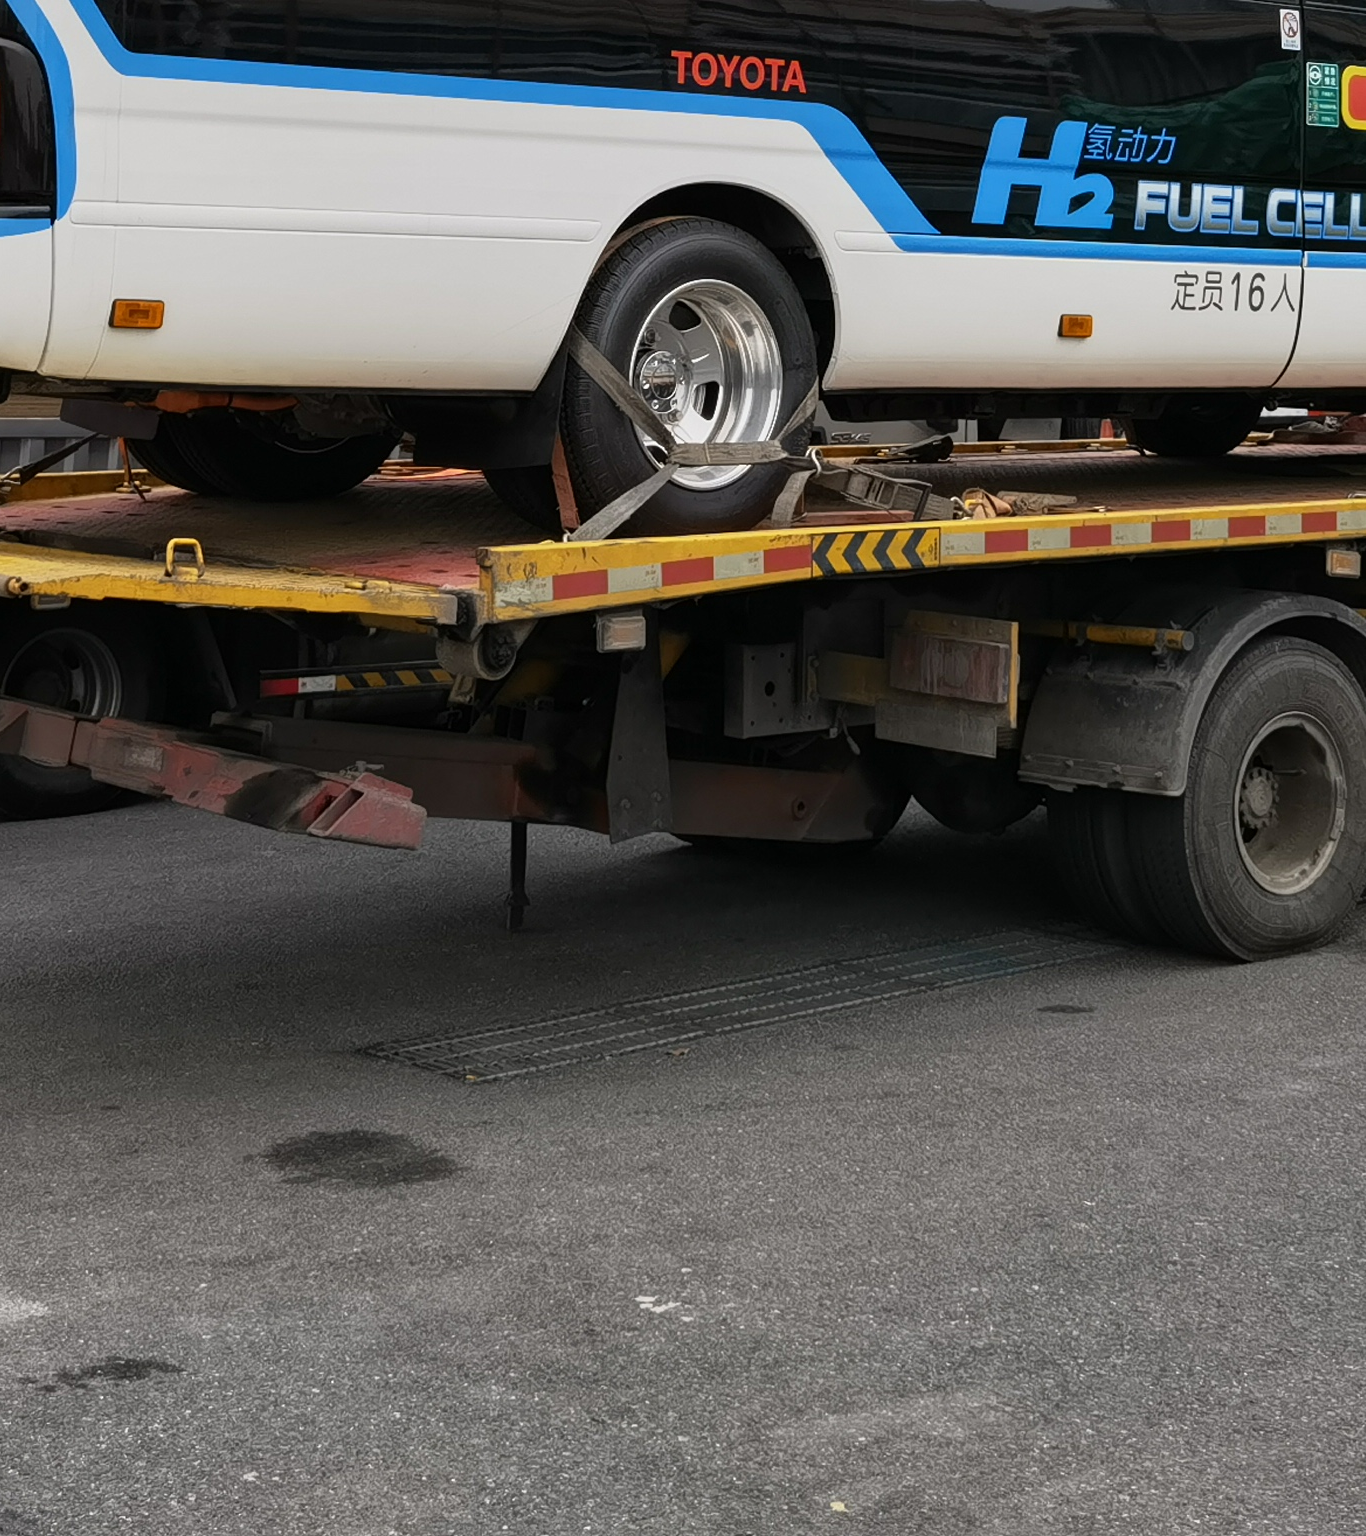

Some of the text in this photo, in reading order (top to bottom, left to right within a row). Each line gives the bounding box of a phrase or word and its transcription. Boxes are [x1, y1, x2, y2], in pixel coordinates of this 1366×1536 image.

[670, 49, 807, 94] TOYOTA
[1083, 123, 1177, 165] 氢动力
[1134, 180, 1259, 236] FUEL
[1170, 270, 1296, 313] 定员16人
